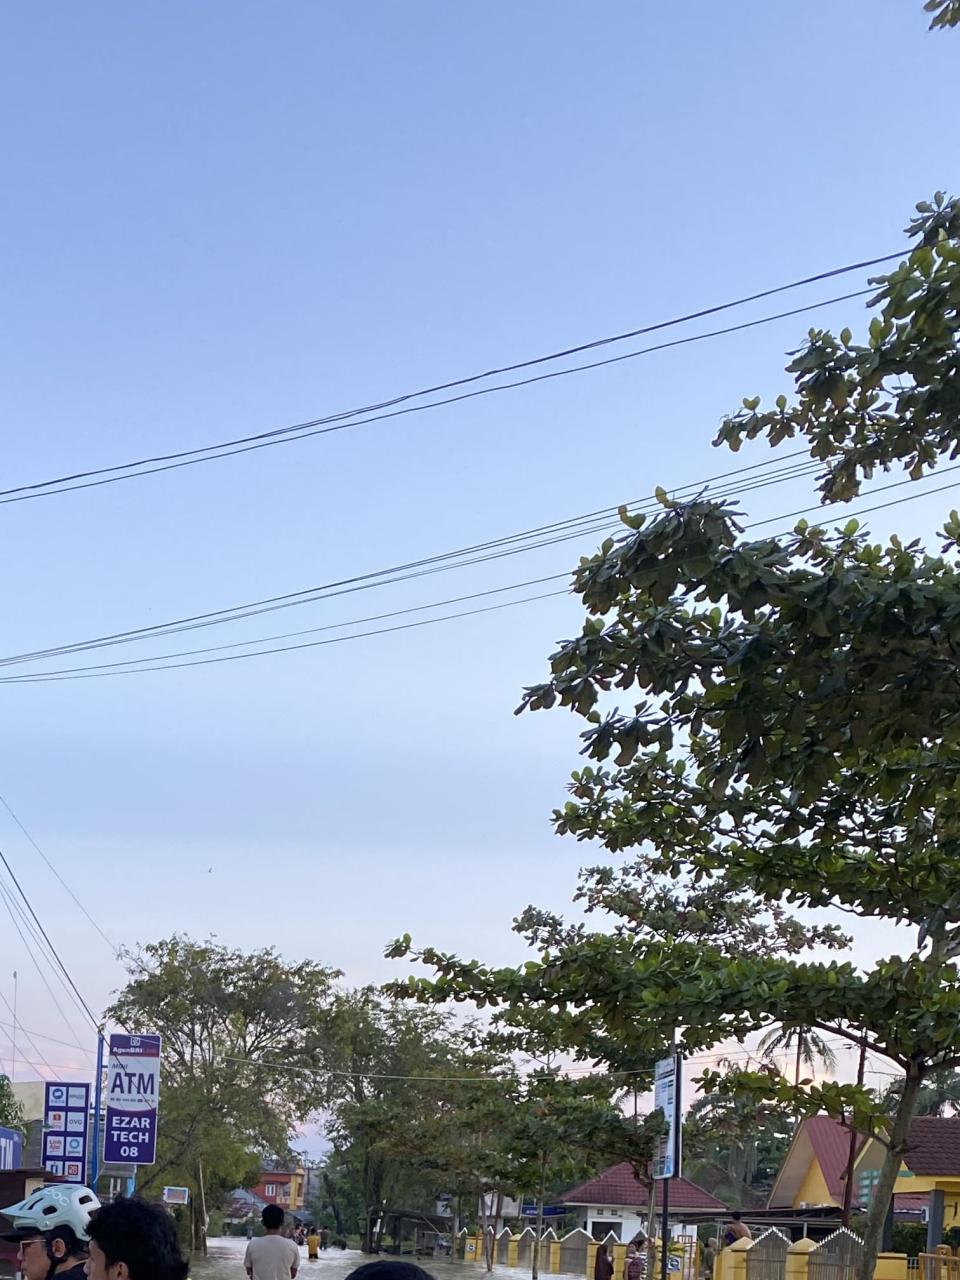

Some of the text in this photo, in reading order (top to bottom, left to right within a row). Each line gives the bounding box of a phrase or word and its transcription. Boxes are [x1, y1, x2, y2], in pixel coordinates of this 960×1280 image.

[110, 1072, 154, 1095] ATM
[112, 1116, 151, 1129] EZAR
[111, 1131, 149, 1143] TECH
[120, 1146, 138, 1157] 08
